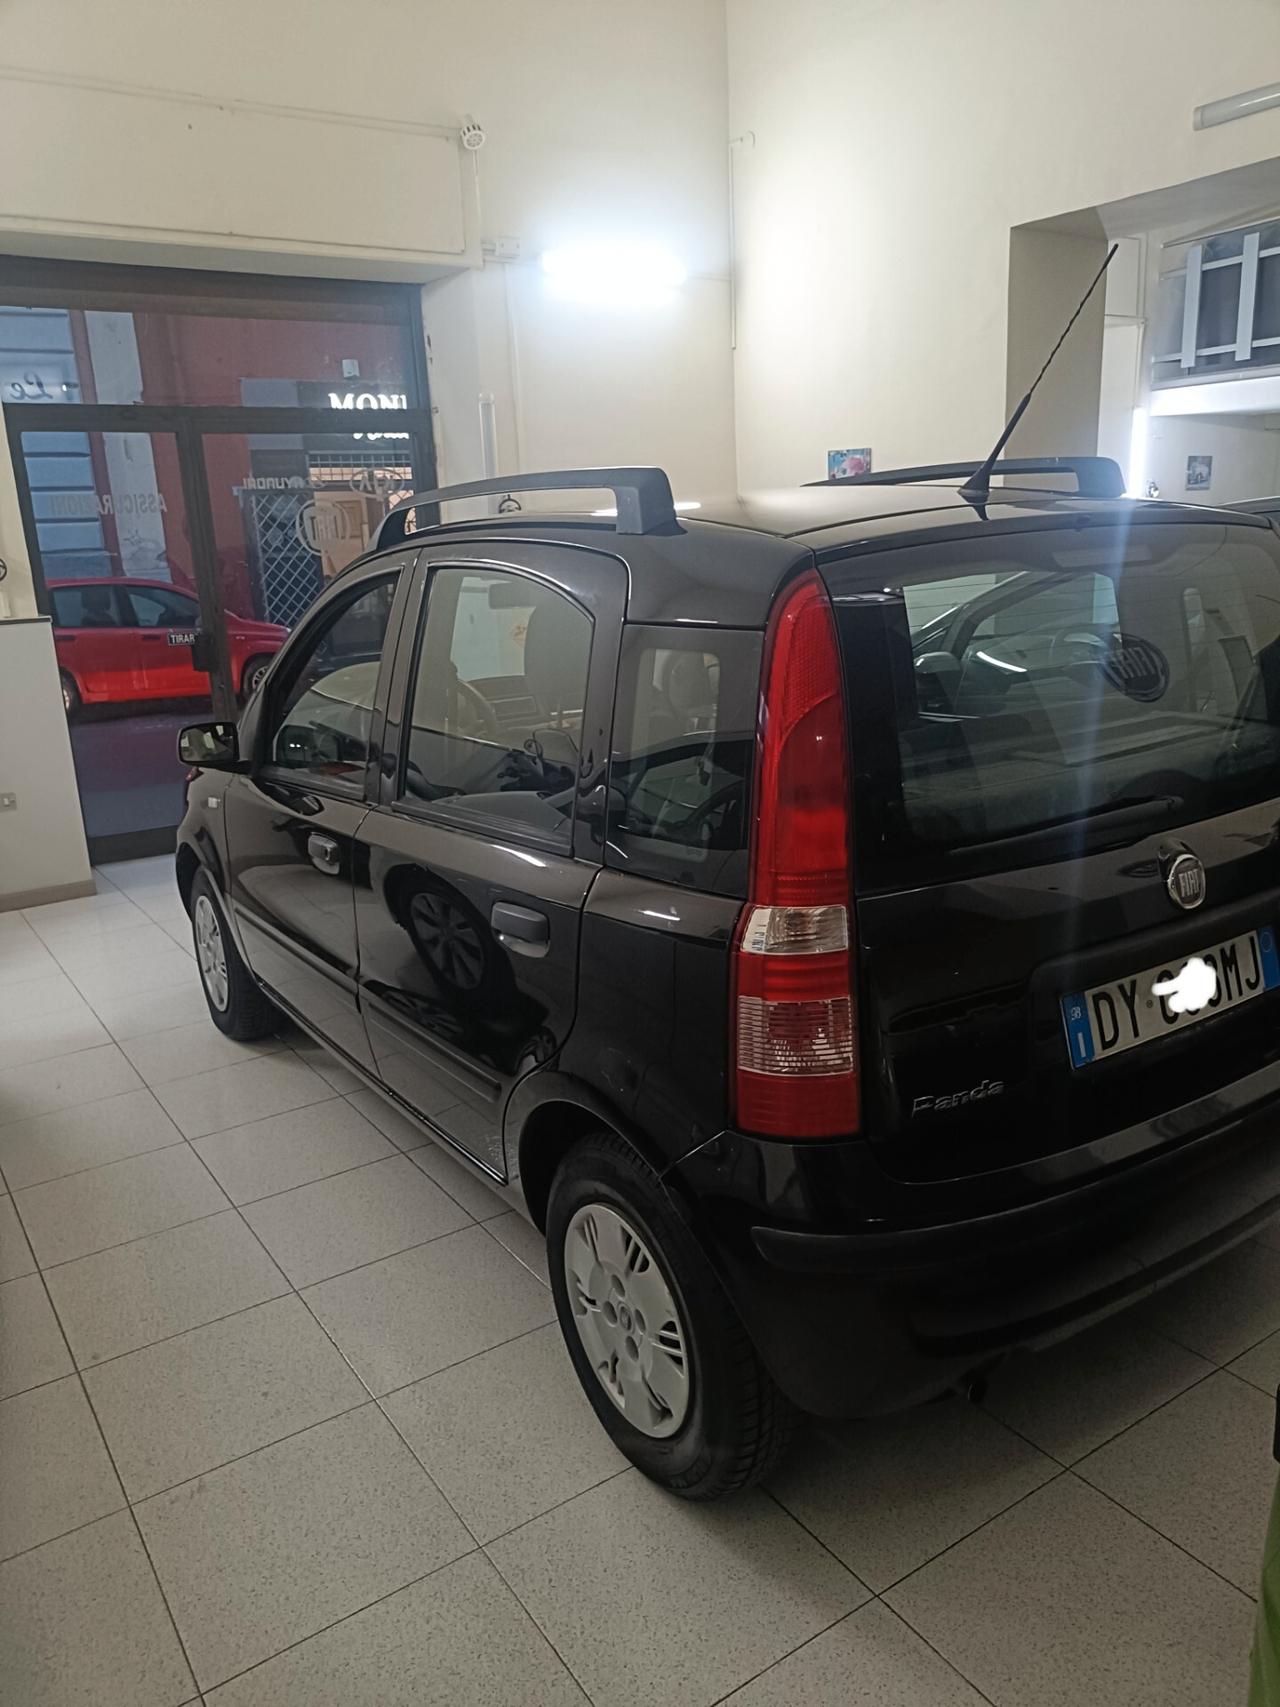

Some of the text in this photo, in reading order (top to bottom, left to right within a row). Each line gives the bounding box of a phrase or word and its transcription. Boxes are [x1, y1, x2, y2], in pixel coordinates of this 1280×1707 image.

[1178, 868, 1200, 897] FIAT
[1093, 980, 1140, 1050] DY
[912, 1079, 1004, 1118] Panda
